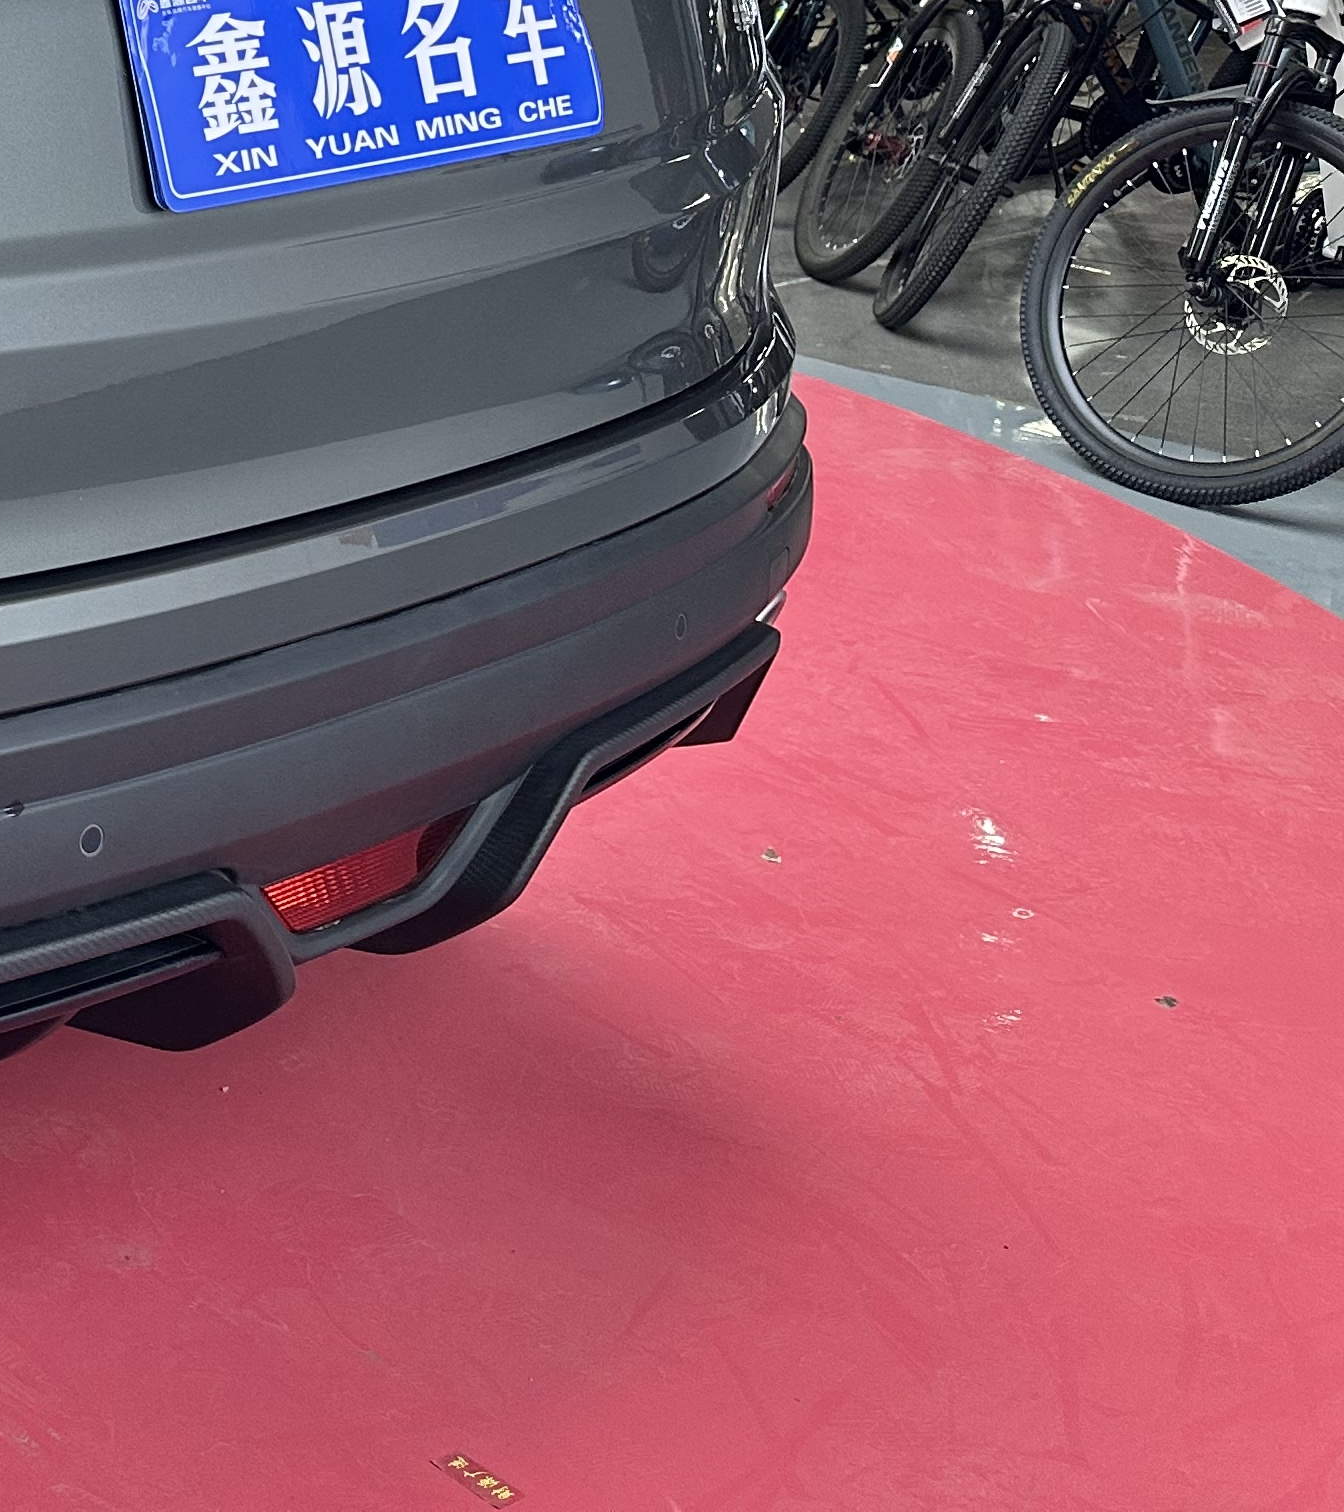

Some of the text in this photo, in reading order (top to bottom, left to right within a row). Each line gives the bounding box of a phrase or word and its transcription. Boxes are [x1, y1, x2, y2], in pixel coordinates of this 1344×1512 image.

[212, 93, 575, 178] XIN YUAN MING CHE
